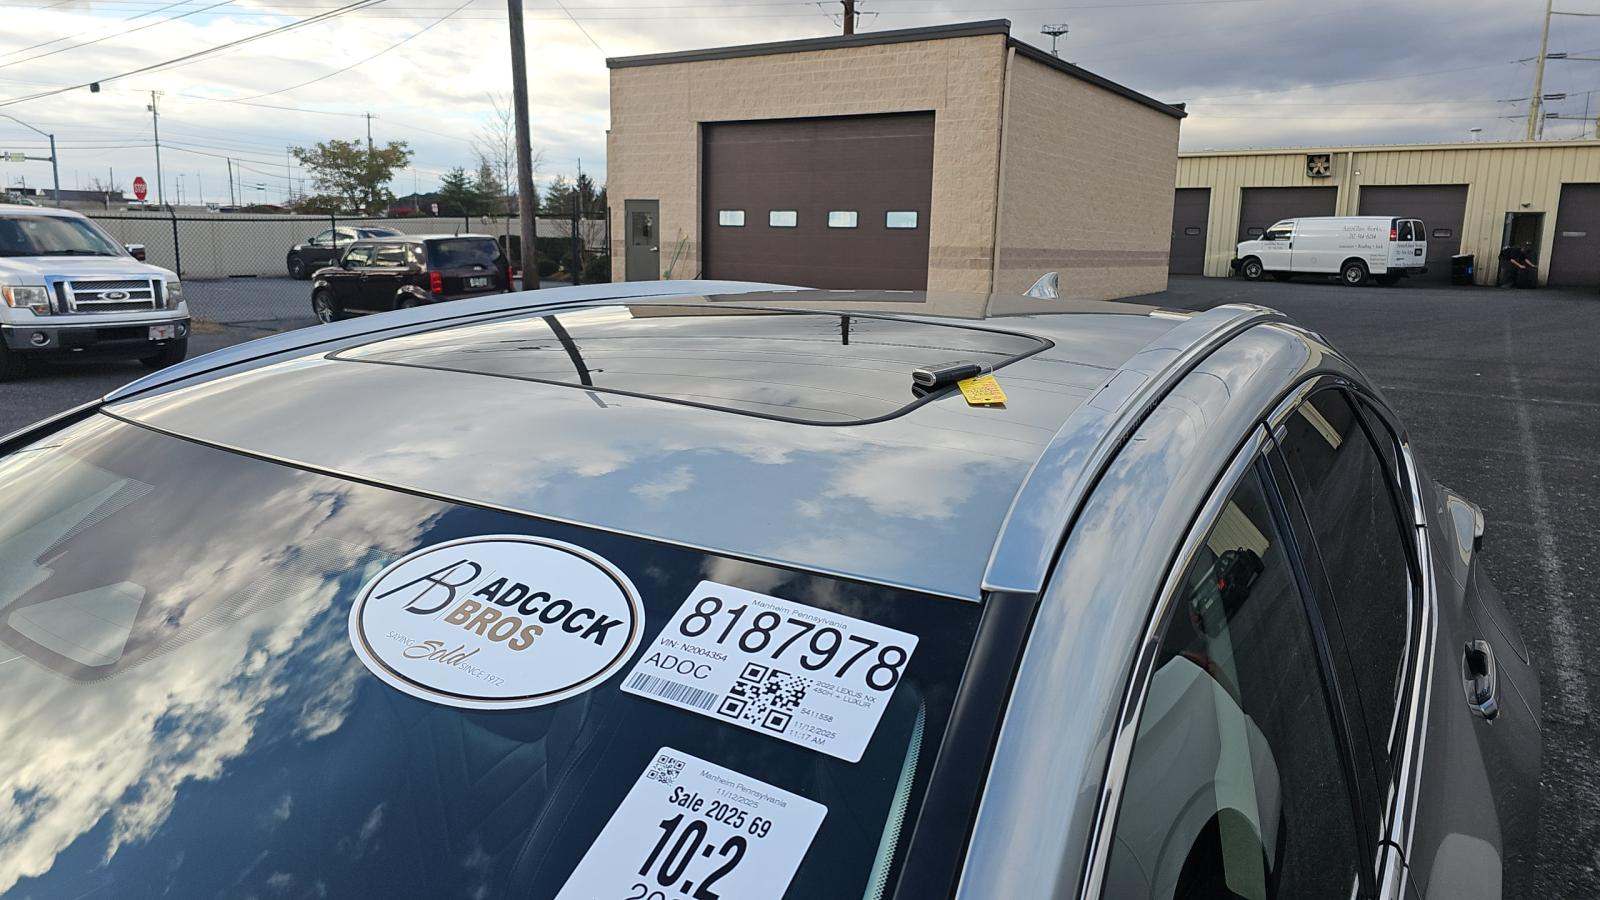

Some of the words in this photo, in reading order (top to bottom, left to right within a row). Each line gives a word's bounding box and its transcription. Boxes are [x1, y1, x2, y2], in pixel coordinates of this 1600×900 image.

[134, 183, 146, 193] STOP
[444, 599, 544, 651] BROS
[473, 577, 624, 646] ADCOCK
[751, 599, 790, 615] Manheim
[791, 609, 848, 630] Pennsylvania
[385, 630, 416, 647] SAYING
[403, 640, 480, 667] Sold
[459, 662, 484, 680] SINCE
[484, 672, 505, 688] 1972
[660, 637, 680, 650] VIN:
[681, 642, 728, 662] N2004354
[679, 596, 908, 692] 8187978
[644, 652, 713, 680] ADOC
[815, 680, 836, 691] 2022
[836, 686, 863, 699] LEXUS
[864, 695, 877, 703] NX
[794, 721, 838, 739] 11/12/2025
[811, 737, 826, 746] AM
[700, 770, 736, 788] Manheim
[736, 783, 788, 808] Pennsylvania
[716, 787, 760, 809] 11/12/2025
[668, 786, 704, 812] Sale
[705, 801, 749, 829] 2025
[748, 816, 772, 838] 69
[638, 814, 747, 900] 10:2
